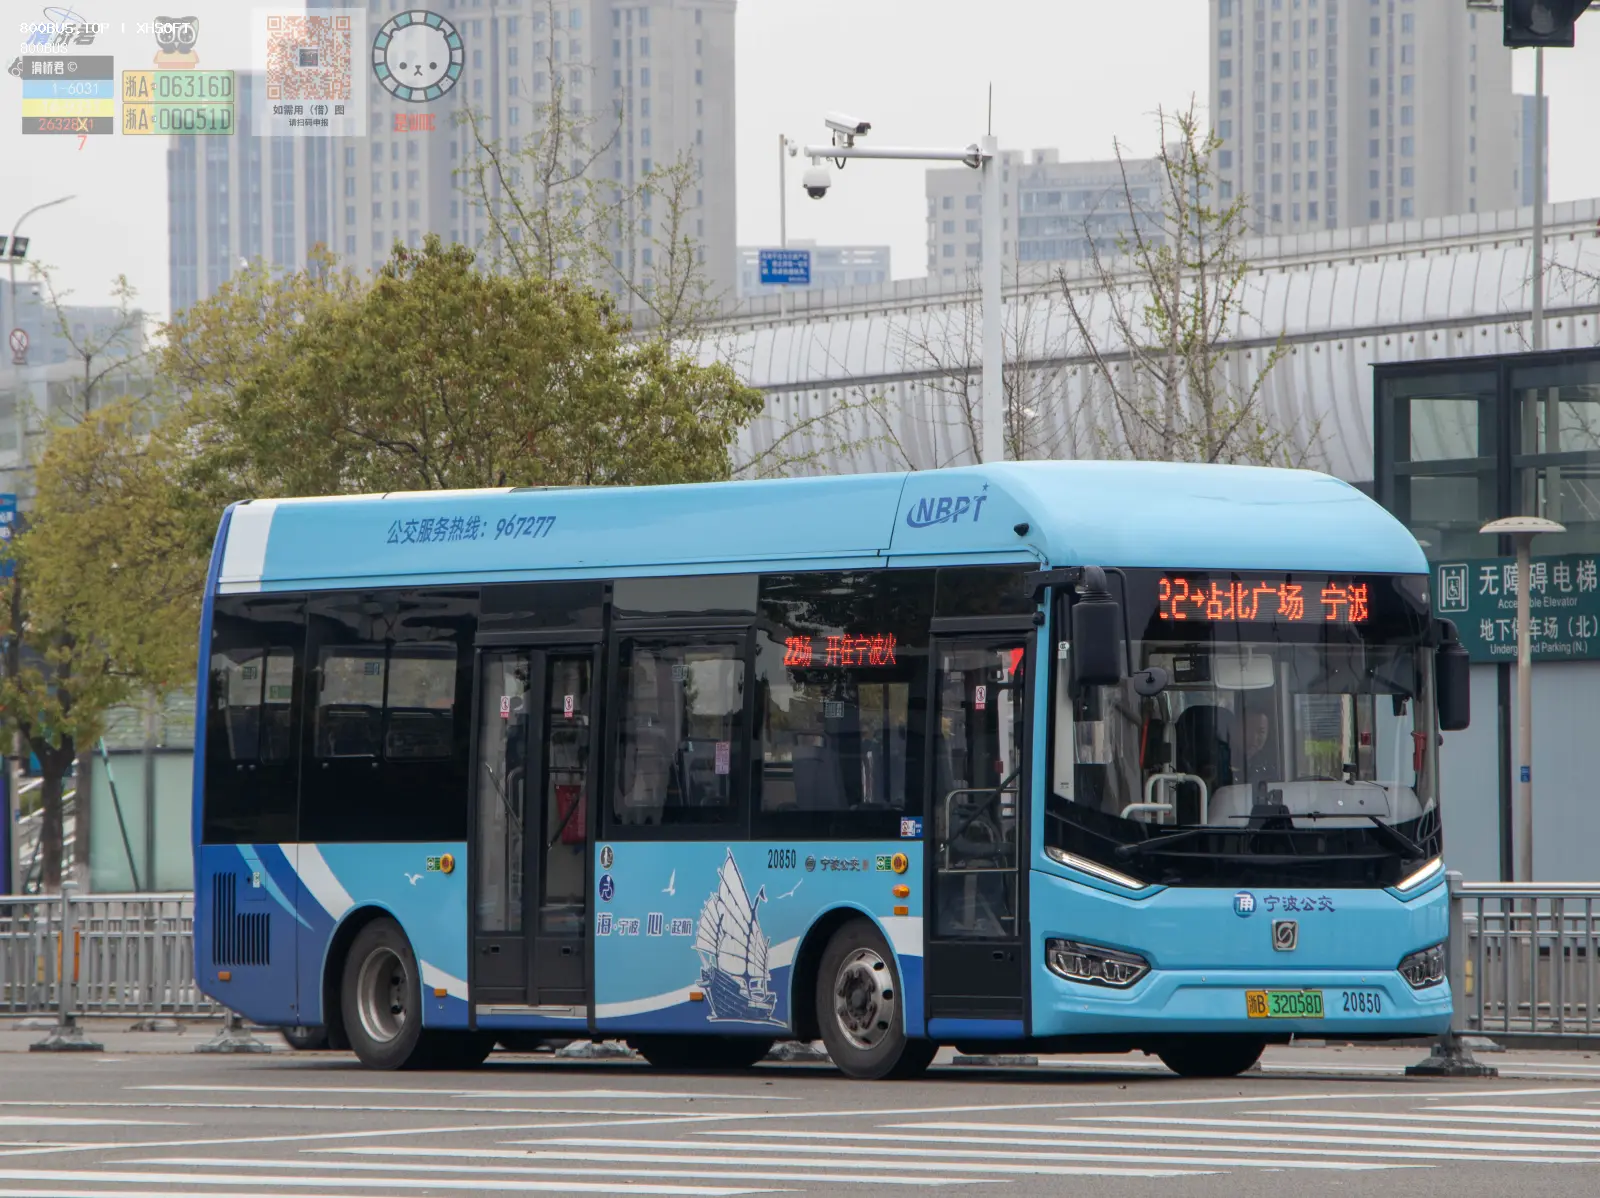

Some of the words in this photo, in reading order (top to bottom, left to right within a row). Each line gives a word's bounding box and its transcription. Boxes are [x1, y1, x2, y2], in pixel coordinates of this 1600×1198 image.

[916, 495, 988, 523] NBPT
[494, 514, 557, 541] 967277
[1497, 597, 1542, 610] Acceble
[1543, 595, 1578, 608] Elevator
[1490, 642, 1541, 656] Undergnd
[1541, 641, 1571, 655] Parking
[767, 849, 797, 869] 20850
[820, 856, 861, 872] 宁波公交
[1263, 895, 1336, 913] 宁波公交
[1342, 991, 1381, 1014] 20850
